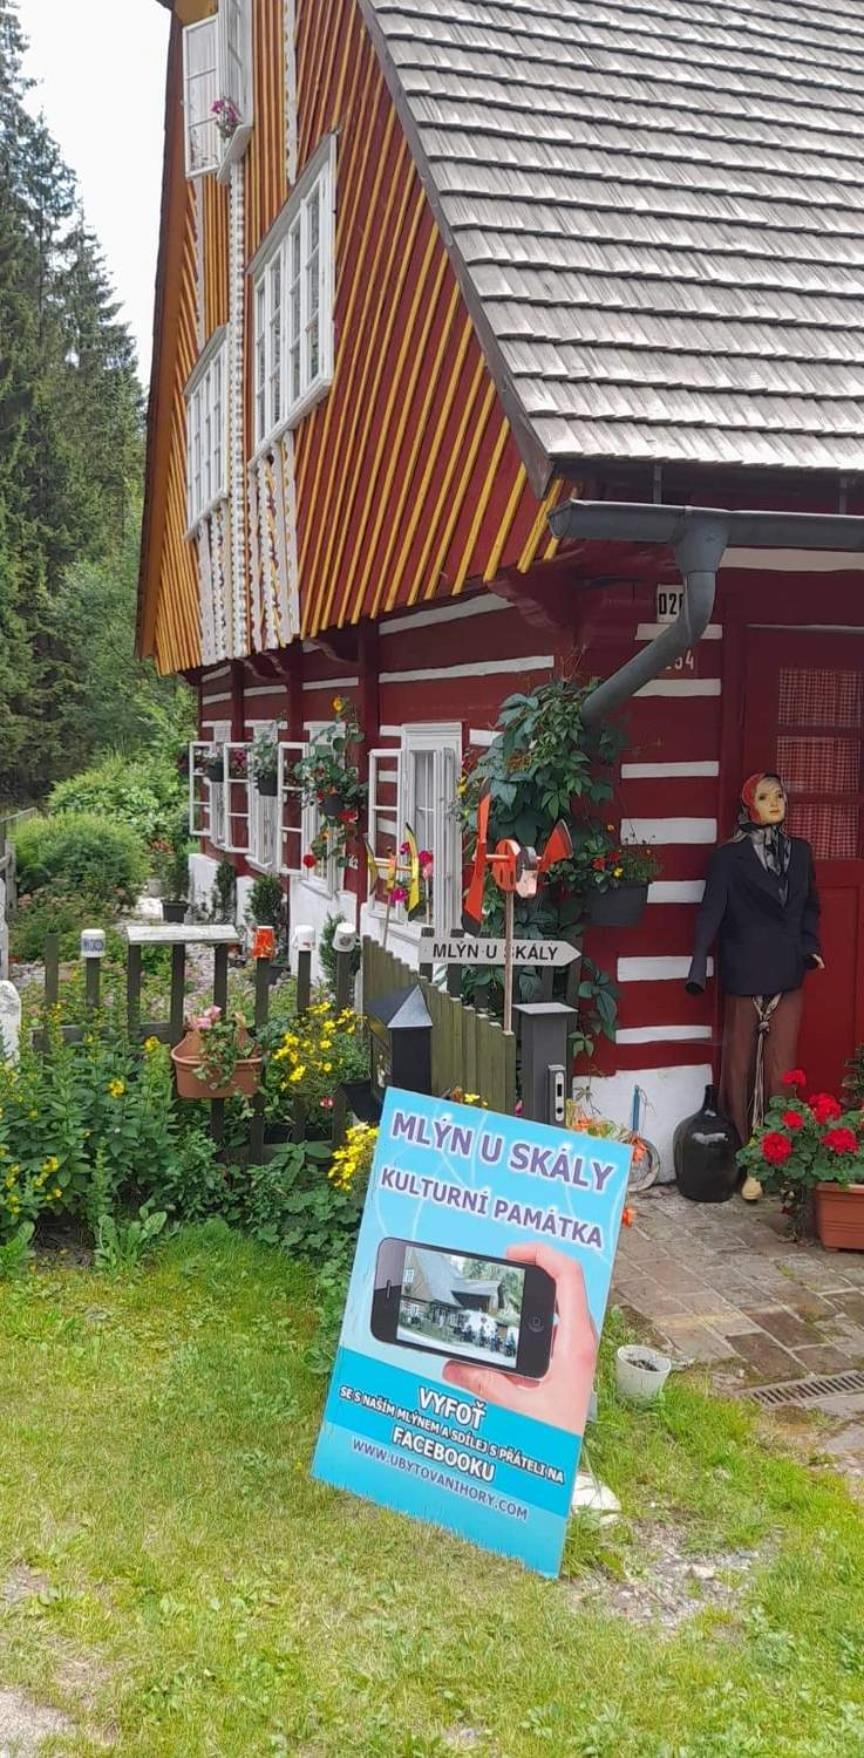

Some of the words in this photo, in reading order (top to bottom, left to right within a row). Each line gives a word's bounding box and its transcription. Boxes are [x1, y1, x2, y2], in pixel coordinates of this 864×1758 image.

[433, 940, 479, 959] MLÝN
[486, 944, 497, 959] U
[504, 942, 558, 961] KÁLY
[392, 1112, 472, 1156] MLÝN
[481, 1134, 503, 1163] U
[510, 1143, 614, 1191] SKÁLY
[381, 1168, 489, 1215] KULTURNÍ
[494, 1200, 603, 1247] PAMÁTKA
[340, 1385, 352, 1400] SE
[353, 1391, 361, 1402] S
[363, 1394, 396, 1417] NAŠÍM
[397, 1409, 440, 1434] MLÝNEM
[442, 1426, 450, 1438] A
[451, 1430, 487, 1453] SDÍLEJ
[489, 1443, 498, 1456] S
[499, 1447, 546, 1477] PŘÁTELI
[548, 1466, 565, 1484] NA
[418, 1387, 487, 1430] VYFOŤ
[353, 1438, 529, 1521] WWW.UBYTOVANIHORY.COM
[393, 1426, 496, 1483] FACEBOOKU
